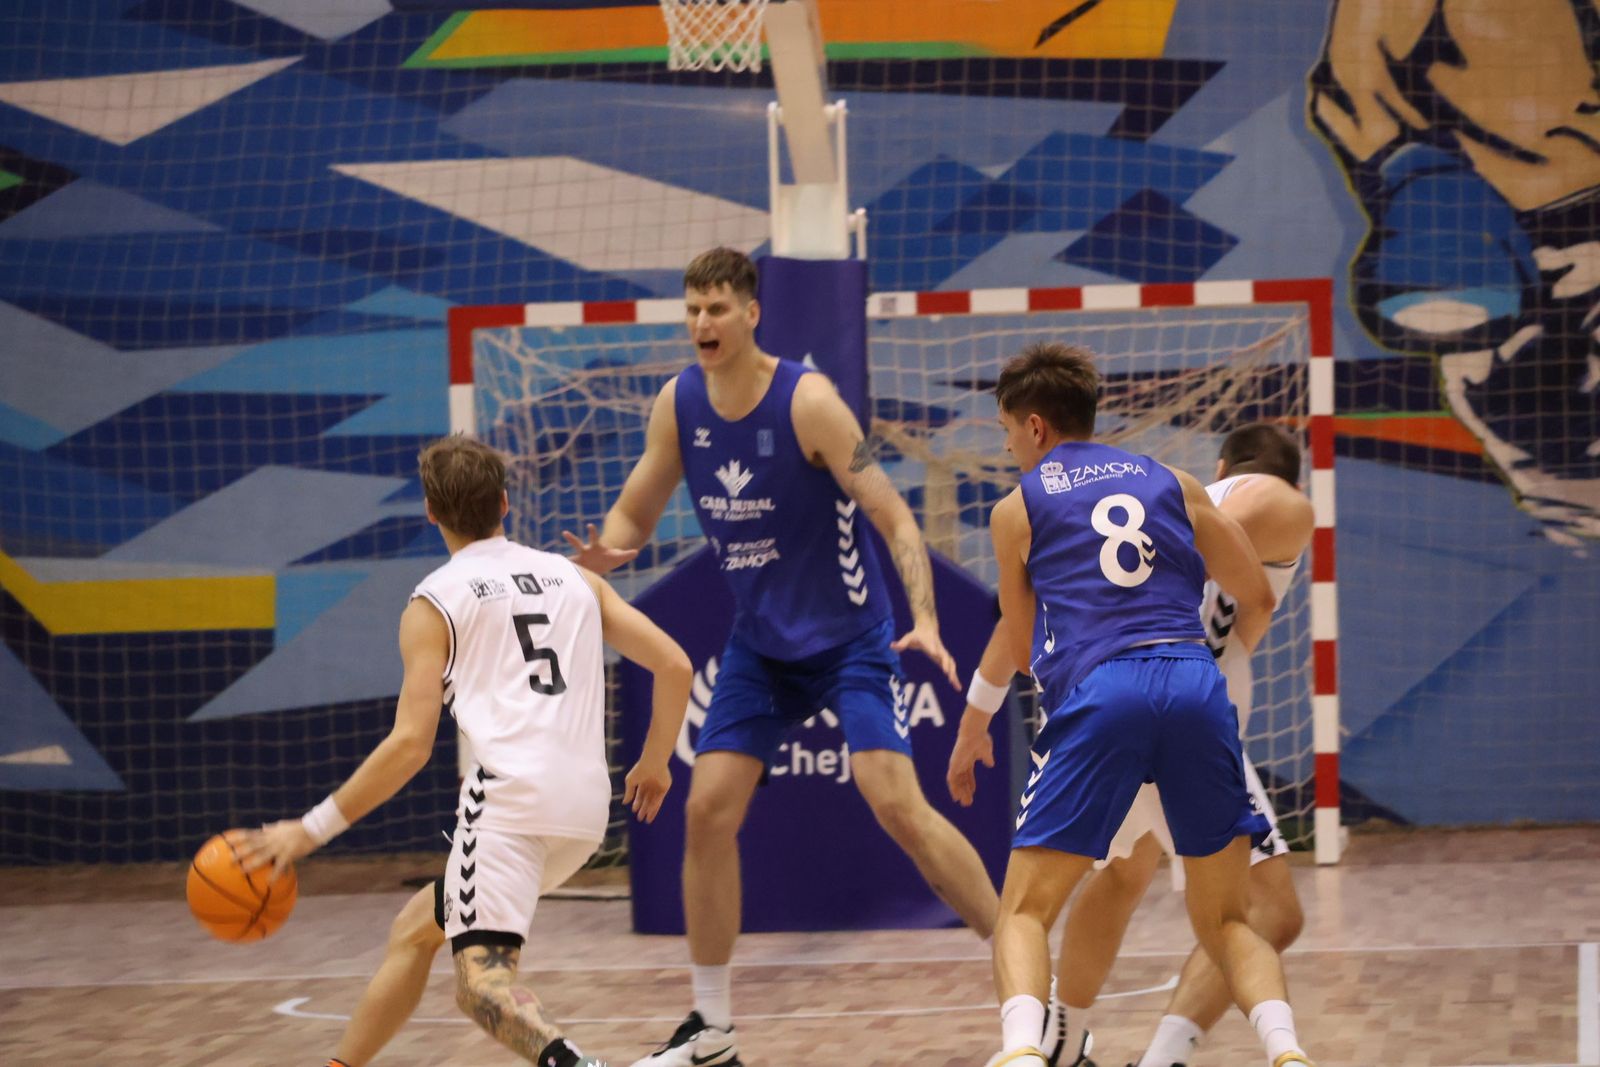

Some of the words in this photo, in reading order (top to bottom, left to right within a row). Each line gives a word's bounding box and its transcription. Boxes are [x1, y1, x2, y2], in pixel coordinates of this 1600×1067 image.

[1069, 462, 1148, 484] ZAMORA
[1091, 493, 1156, 588] 8
[512, 613, 568, 696] 5
